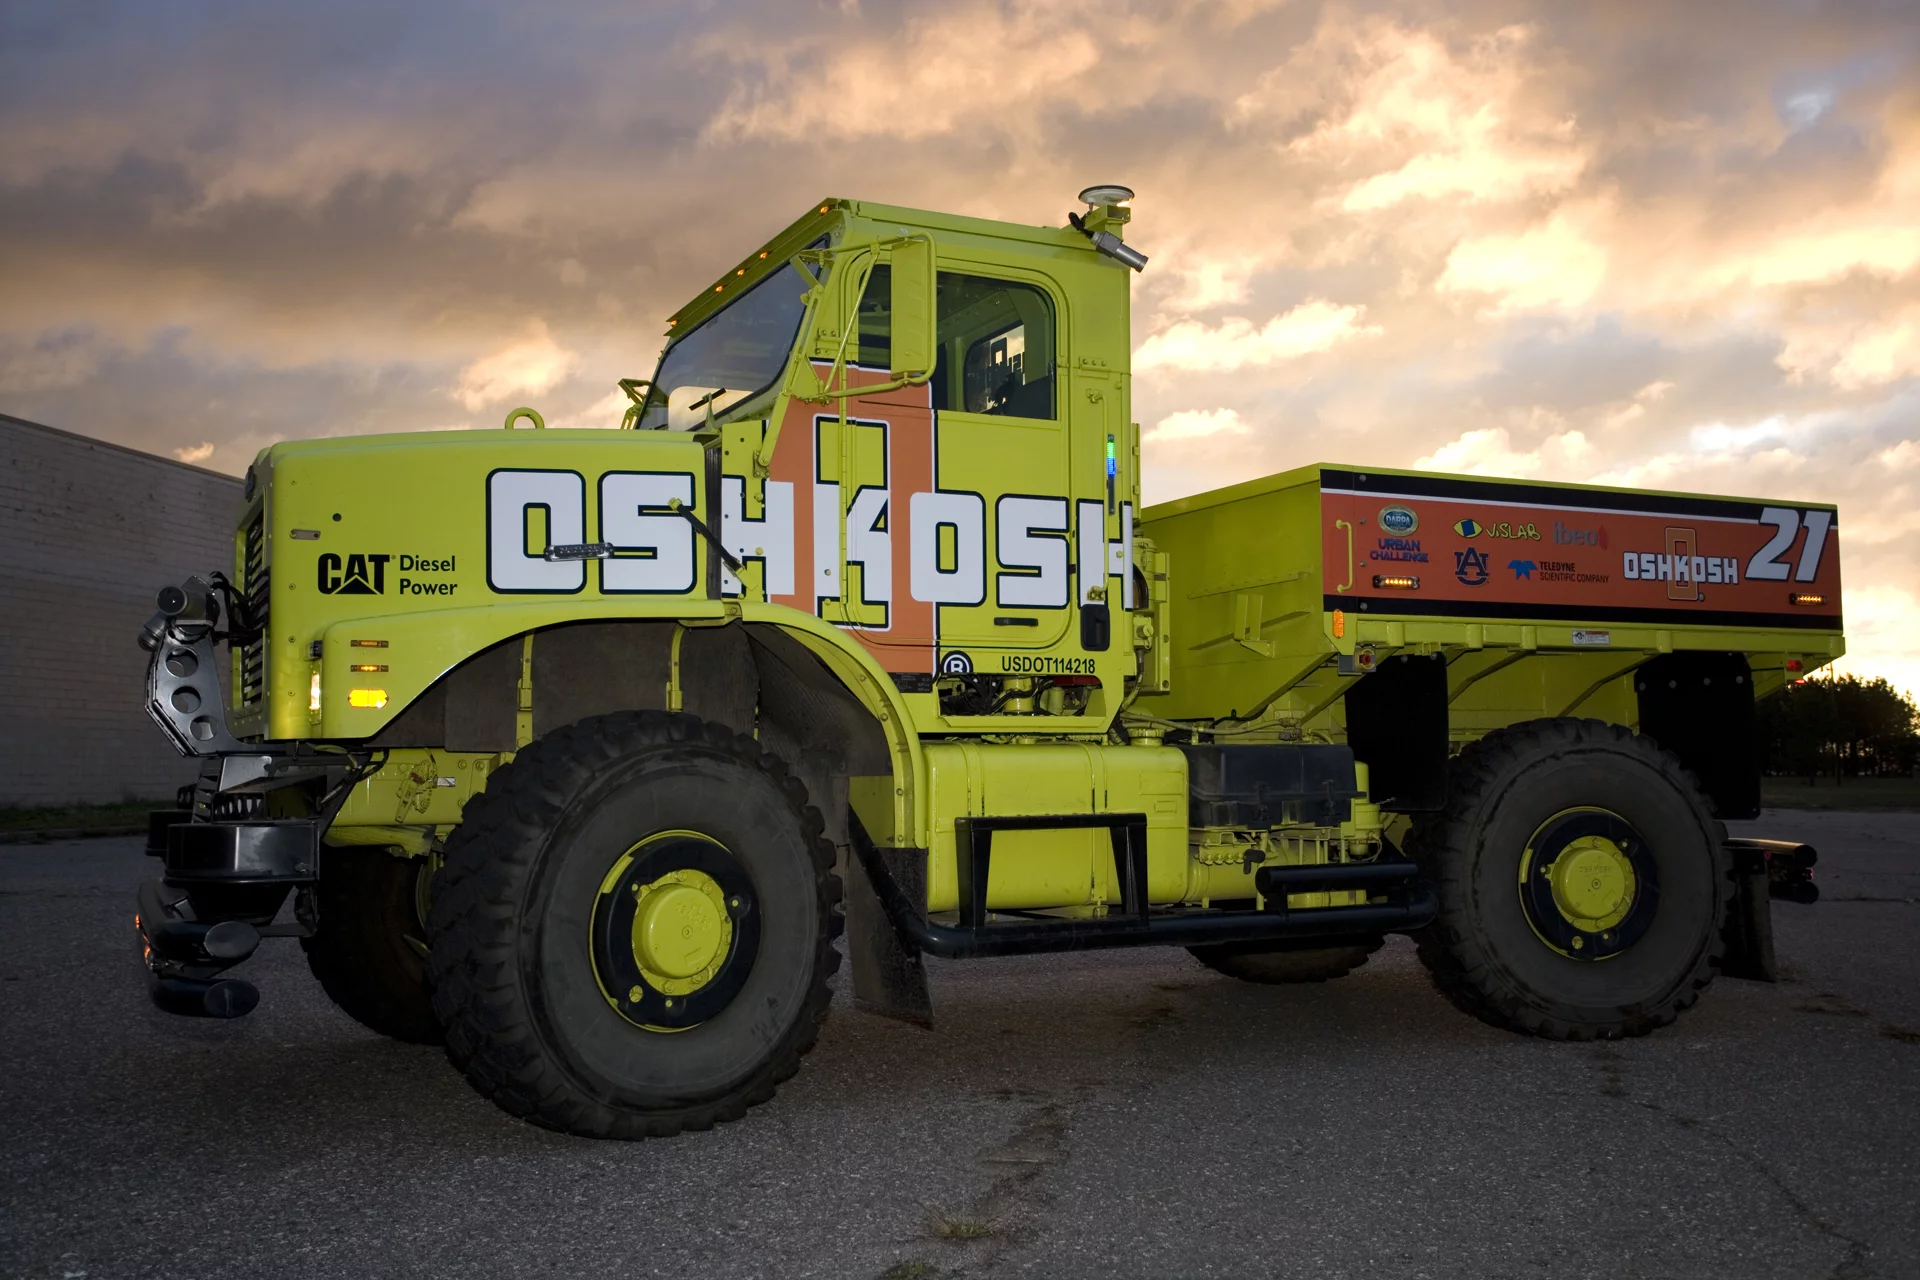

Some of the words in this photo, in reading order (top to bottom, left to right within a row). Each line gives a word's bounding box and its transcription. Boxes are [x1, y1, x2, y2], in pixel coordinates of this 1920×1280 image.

[1385, 514, 1411, 526] DARPA
[486, 468, 1134, 611] OSHKOSH
[1553, 521, 1598, 546] ibeo
[1378, 538, 1421, 552] URBAN
[1744, 507, 1832, 582] 21
[399, 554, 456, 572] Diesel
[1369, 550, 1429, 563] CHALLENGE
[317, 553, 390, 595] CAT
[1540, 561, 1576, 572] TELEDYNE
[1623, 552, 1739, 584] OSHKOSH
[1540, 571, 1576, 583] SCIENTIFIC
[1576, 573, 1609, 583] COMPANY
[399, 578, 458, 595] Power
[1001, 655, 1096, 674] USDOT114218
